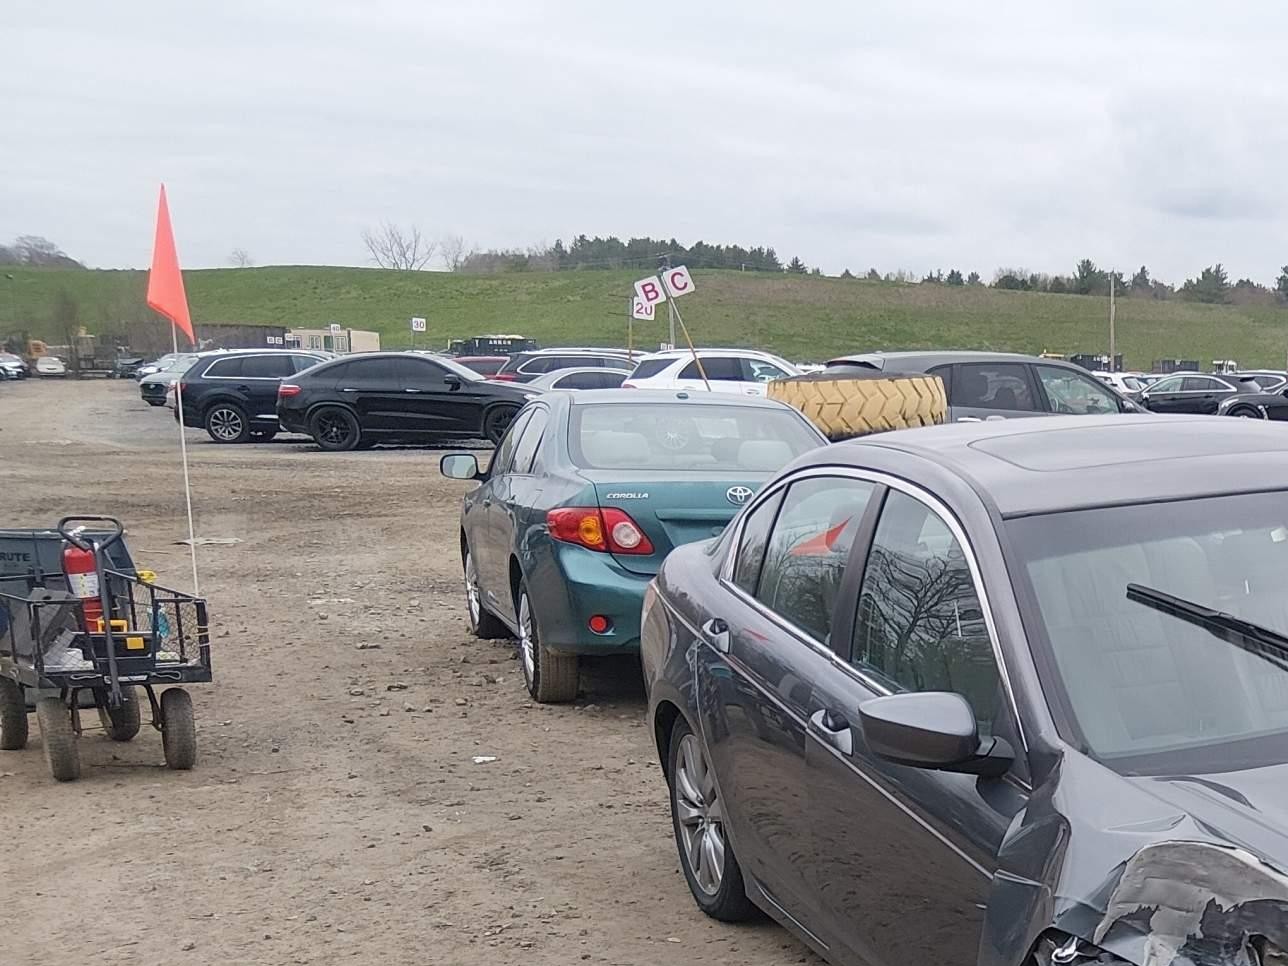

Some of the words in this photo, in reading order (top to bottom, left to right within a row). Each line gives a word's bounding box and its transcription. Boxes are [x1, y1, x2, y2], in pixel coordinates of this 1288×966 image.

[670, 272, 688, 291] C
[641, 282, 660, 303] B
[414, 319, 425, 329] 30
